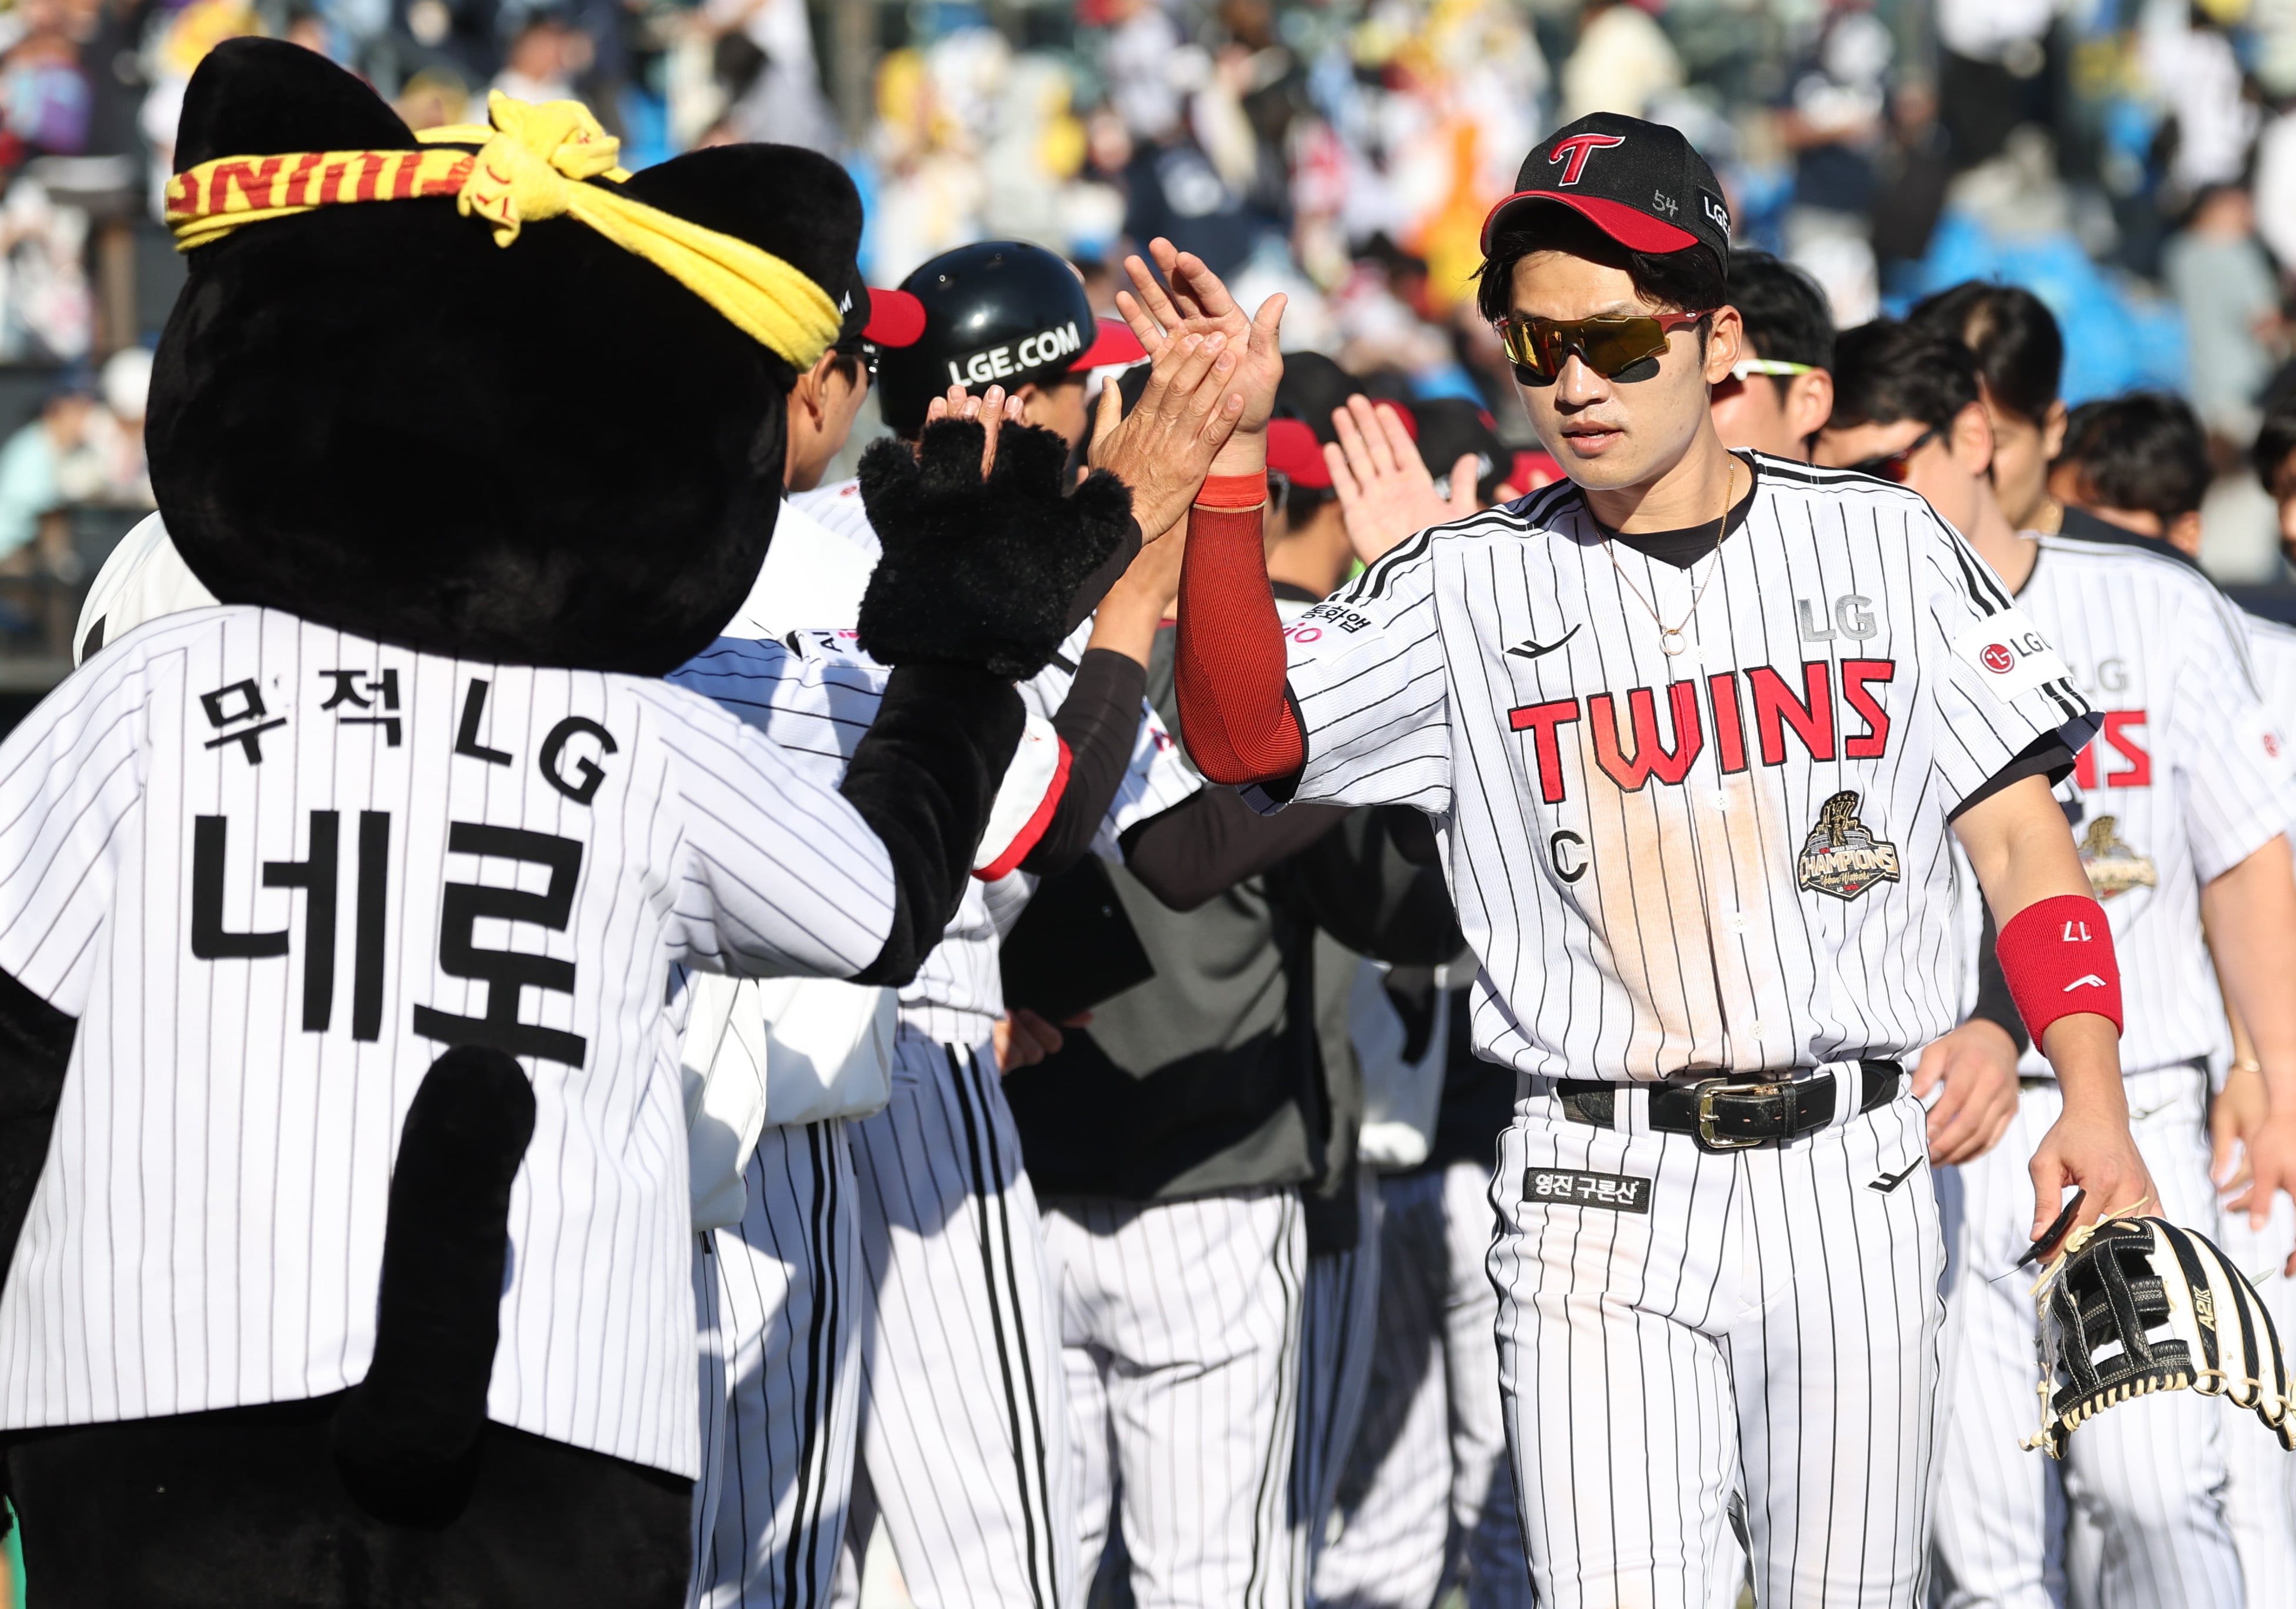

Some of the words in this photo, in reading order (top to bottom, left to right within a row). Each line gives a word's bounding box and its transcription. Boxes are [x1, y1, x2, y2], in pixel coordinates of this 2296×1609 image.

[1548, 133, 1625, 186] T
[1652, 189, 1678, 217] 54
[948, 321, 1081, 387] LGE.COM
[1797, 594, 1878, 642] LG
[199, 668, 402, 766] 무적
[454, 677, 618, 807] LG
[1508, 658, 1895, 804] TWINS
[1550, 827, 1589, 887] C
[1800, 847, 1898, 882] CHAMPIONS
[191, 810, 588, 1071] 네로
[1535, 1174, 1573, 1197] 영진
[1577, 1177, 1639, 1205] 구론산
[2192, 1285, 2215, 1332] A2K
